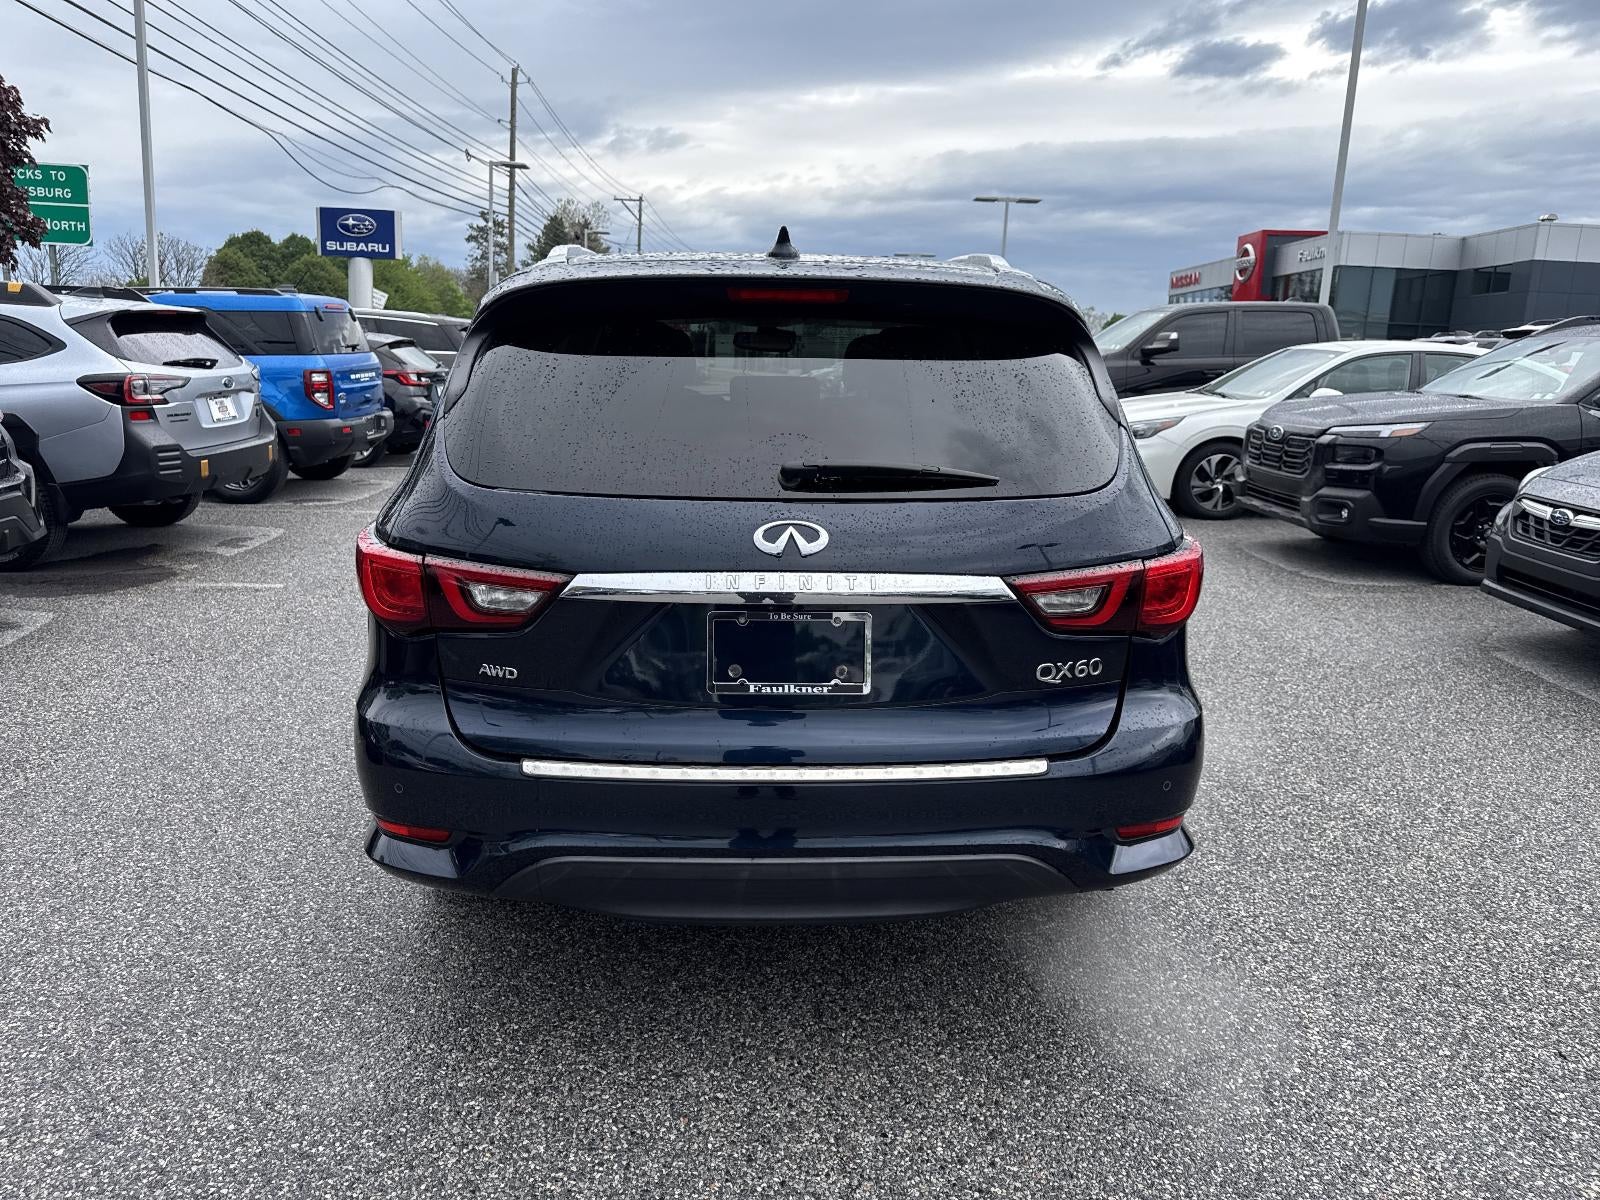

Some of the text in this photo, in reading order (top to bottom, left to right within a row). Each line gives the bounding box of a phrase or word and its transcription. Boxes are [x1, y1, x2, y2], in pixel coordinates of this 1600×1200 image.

[50, 170, 66, 181] TO
[25, 186, 72, 198] SBURG
[326, 241, 390, 253] SUBARU
[1171, 271, 1201, 289] NISSAN
[705, 574, 877, 591] INFINITI
[769, 612, 812, 620] To Be Sure
[478, 663, 518, 679] AWD
[1036, 657, 1103, 684] QX60
[749, 684, 833, 694] Faulkner
